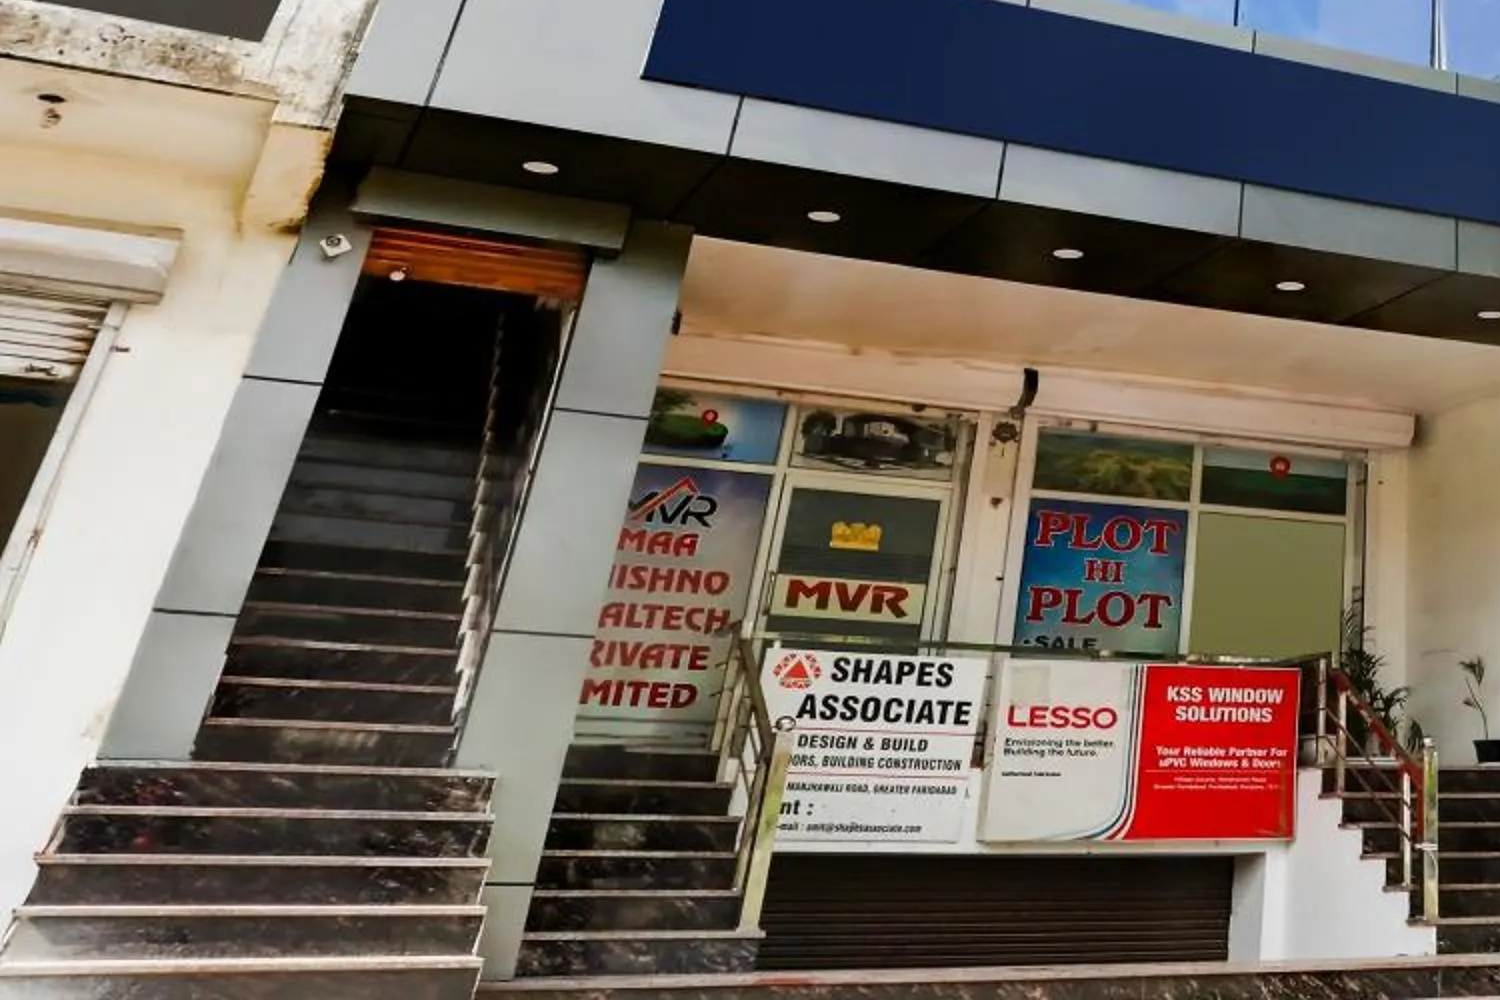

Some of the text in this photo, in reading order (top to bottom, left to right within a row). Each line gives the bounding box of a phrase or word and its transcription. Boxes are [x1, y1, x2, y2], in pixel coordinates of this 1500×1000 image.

[617, 527, 699, 557] MAA
[1034, 510, 1181, 556] PLOT
[608, 564, 731, 596] ISHNO
[1084, 558, 1126, 584] HI
[784, 579, 910, 620] MVR
[1025, 585, 1172, 630] PLOT
[831, 657, 955, 688] SHAPES
[1167, 686, 1283, 704] KSS WINDOW
[795, 694, 973, 726] ASSOCIATE
[1007, 705, 1118, 729] LESSO
[1175, 705, 1273, 723] SOLUTIONS
[797, 734, 929, 752] DESIGN & BUILD
[1156, 745, 1288, 757] Your Reliable Partner For
[788, 754, 962, 771] ORS, BUILDING CONSTRUCTION
[1190, 758, 1238, 768] Windows
